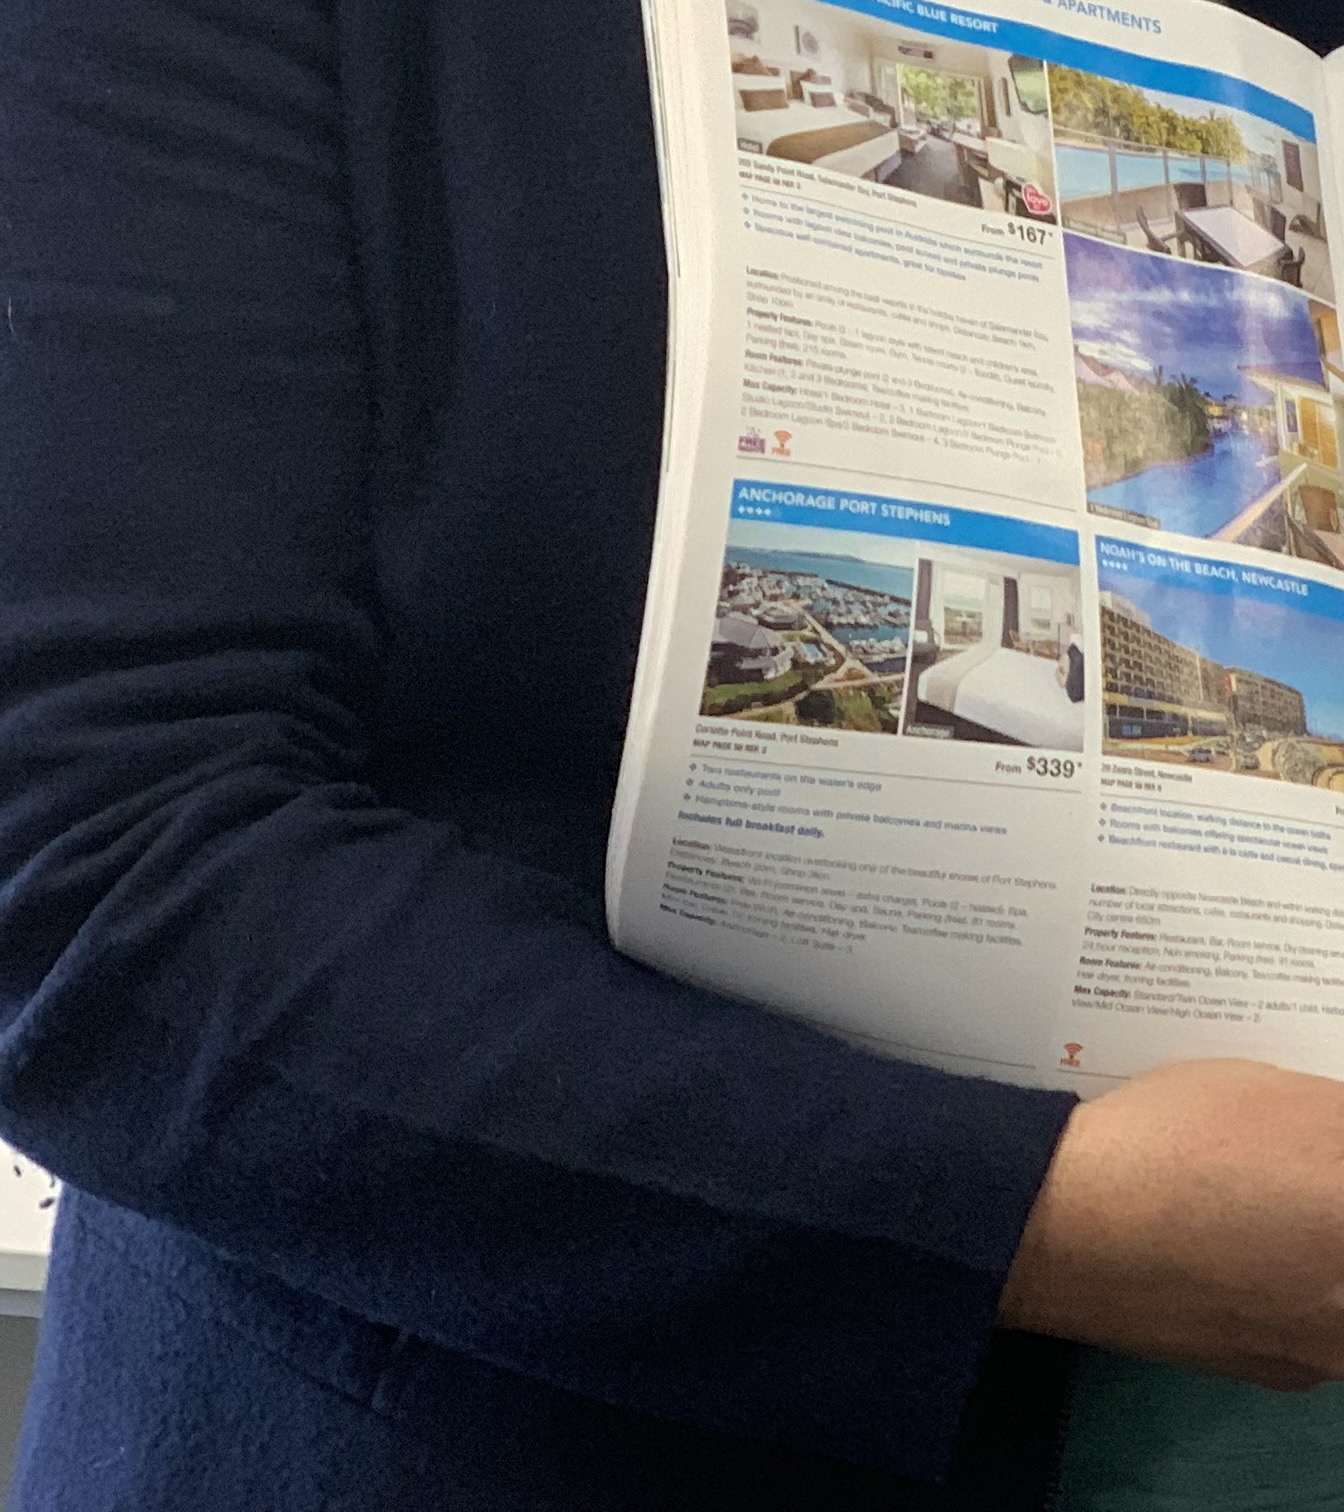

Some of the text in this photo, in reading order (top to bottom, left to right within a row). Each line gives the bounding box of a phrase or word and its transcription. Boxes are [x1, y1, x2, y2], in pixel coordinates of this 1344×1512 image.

[917, 4, 947, 22] BLUE
[950, 12, 998, 34] RESORT
[738, 486, 951, 527] ANCHORAGE PORT STEPHENS
[1099, 541, 1309, 597] NOAH'S ON THE BEACH, NEWCASTLE
[994, 759, 1022, 776] From
